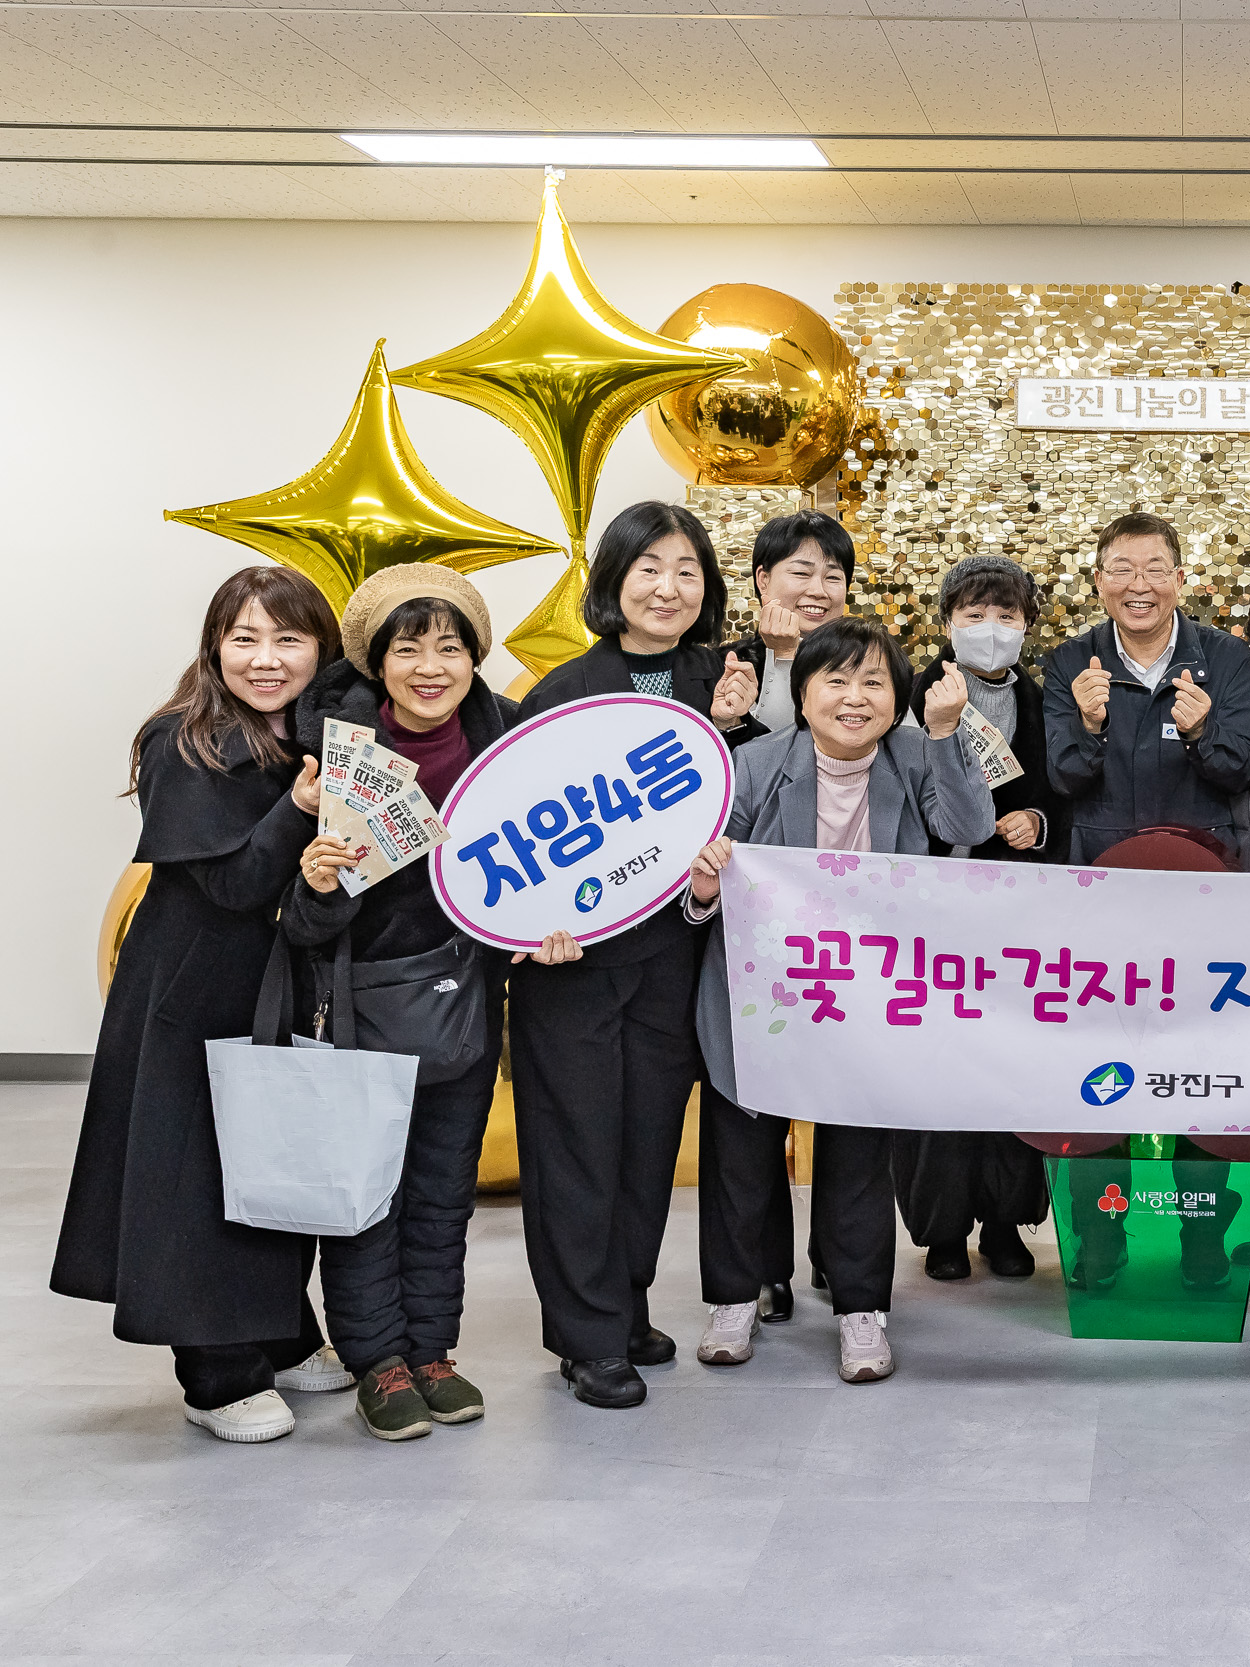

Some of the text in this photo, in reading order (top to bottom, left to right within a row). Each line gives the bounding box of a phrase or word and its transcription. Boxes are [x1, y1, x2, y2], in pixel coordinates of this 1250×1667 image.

[1041, 385, 1250, 420] 광진 나눔의 날
[327, 750, 352, 769] 따뜻
[343, 745, 357, 755] 희망
[326, 765, 347, 780] 겨울
[984, 755, 1002, 780] 뜻한
[349, 781, 384, 804] 겨울나
[398, 798, 413, 817] 2026
[457, 729, 702, 908] 자양4동
[377, 808, 412, 855] 겨울나기
[386, 802, 424, 850] 따뜻한
[606, 845, 663, 886] 광진구
[1144, 1073, 1245, 1099] 광진구
[1131, 1191, 1216, 1209] 사랑의 열매
